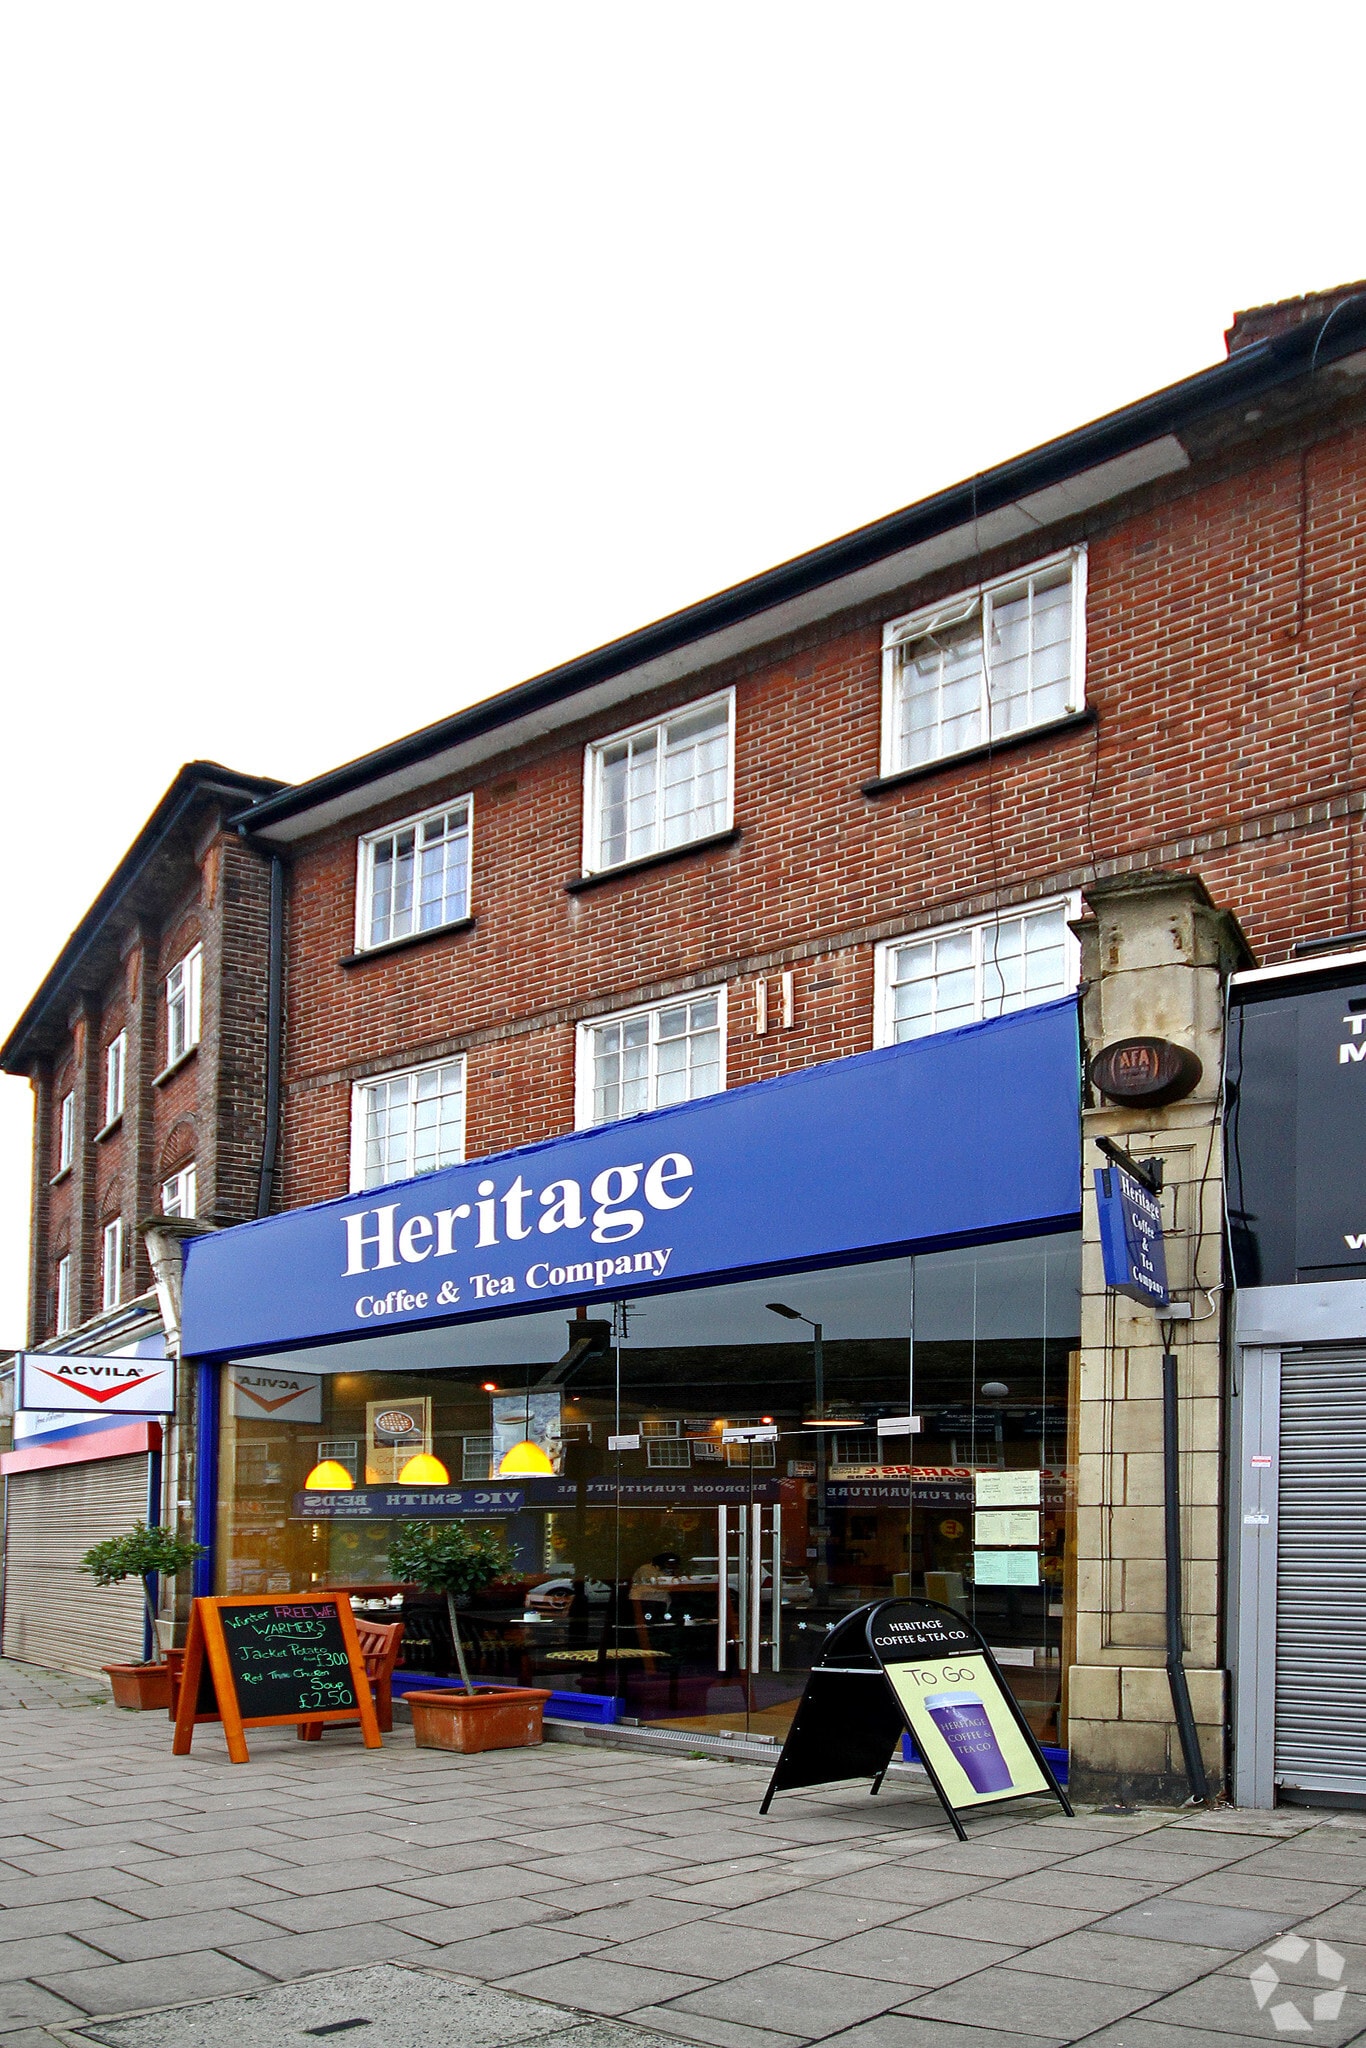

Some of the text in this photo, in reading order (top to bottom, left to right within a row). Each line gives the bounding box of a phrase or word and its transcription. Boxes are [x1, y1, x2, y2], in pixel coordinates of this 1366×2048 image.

[1121, 1176, 1160, 1220] Heritage
[339, 1152, 694, 1277] Heritage
[1132, 1213, 1155, 1239] Coffee
[1142, 1238, 1149, 1252] &
[1140, 1253, 1154, 1272] Tea
[355, 1247, 674, 1319] Coffee & Tea Company
[1132, 1266, 1164, 1298] Company
[225, 1611, 269, 1629] Winter
[252, 1620, 326, 1635] WARMERS
[889, 1619, 943, 1632] HERITAGE
[875, 1630, 969, 1646] COFFEE & TEA CO.
[238, 1646, 288, 1661] Jacket
[310, 1677, 344, 1691] Soup
[299, 1689, 352, 1709] £2.50
[941, 1718, 987, 1731] HERITAGE
[948, 1730, 992, 1743] COFFEE &
[957, 1744, 976, 1754] TEA
